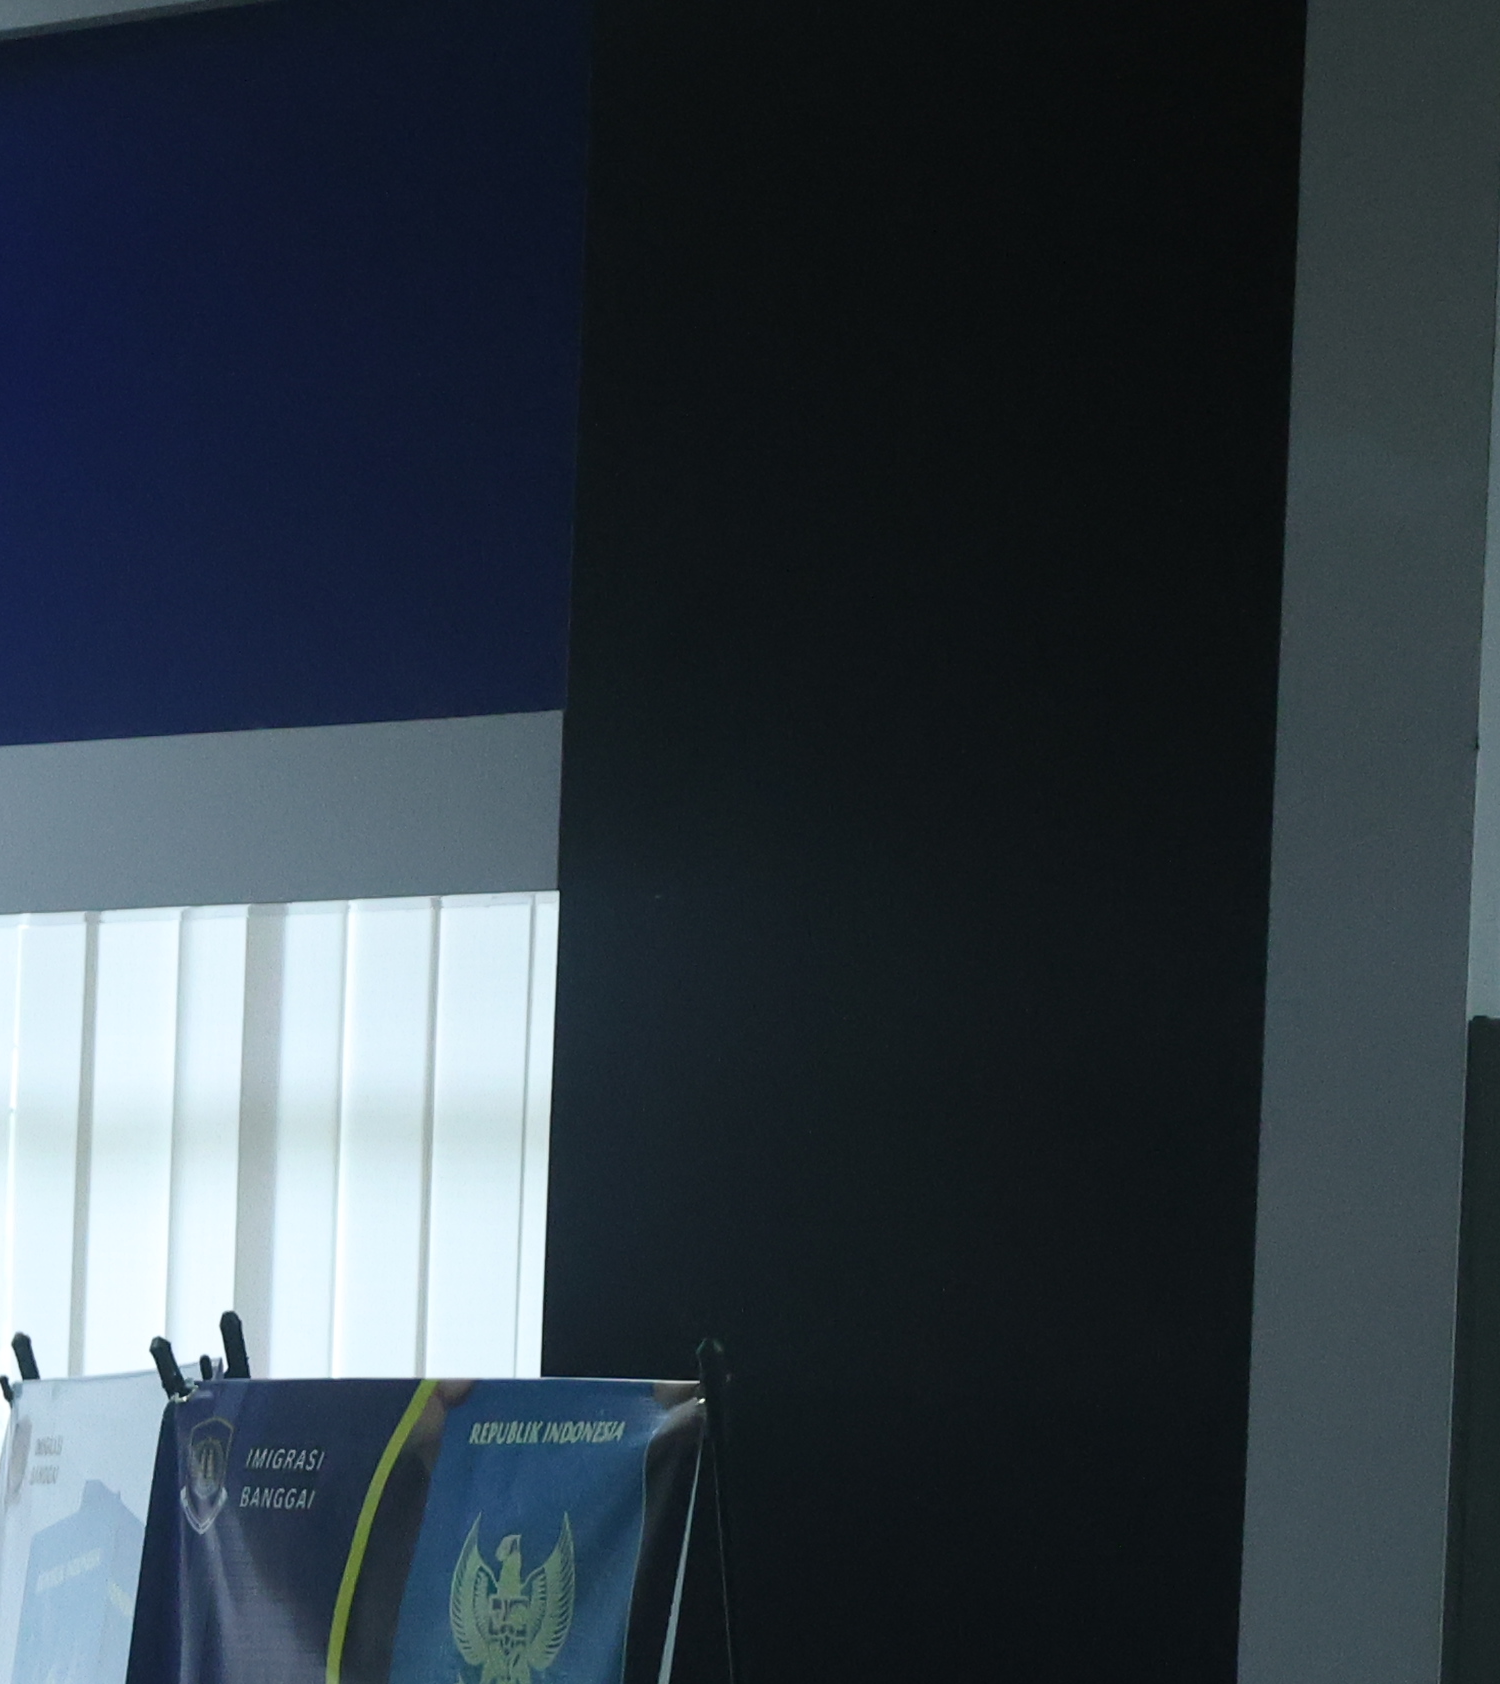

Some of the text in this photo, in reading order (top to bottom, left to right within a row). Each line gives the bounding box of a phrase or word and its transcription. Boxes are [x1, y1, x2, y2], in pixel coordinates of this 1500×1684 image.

[469, 1420, 626, 1445] REPUBLIK INDONESIA
[245, 1447, 325, 1471] IMIGRASI
[239, 1486, 314, 1510] BANGGAI
